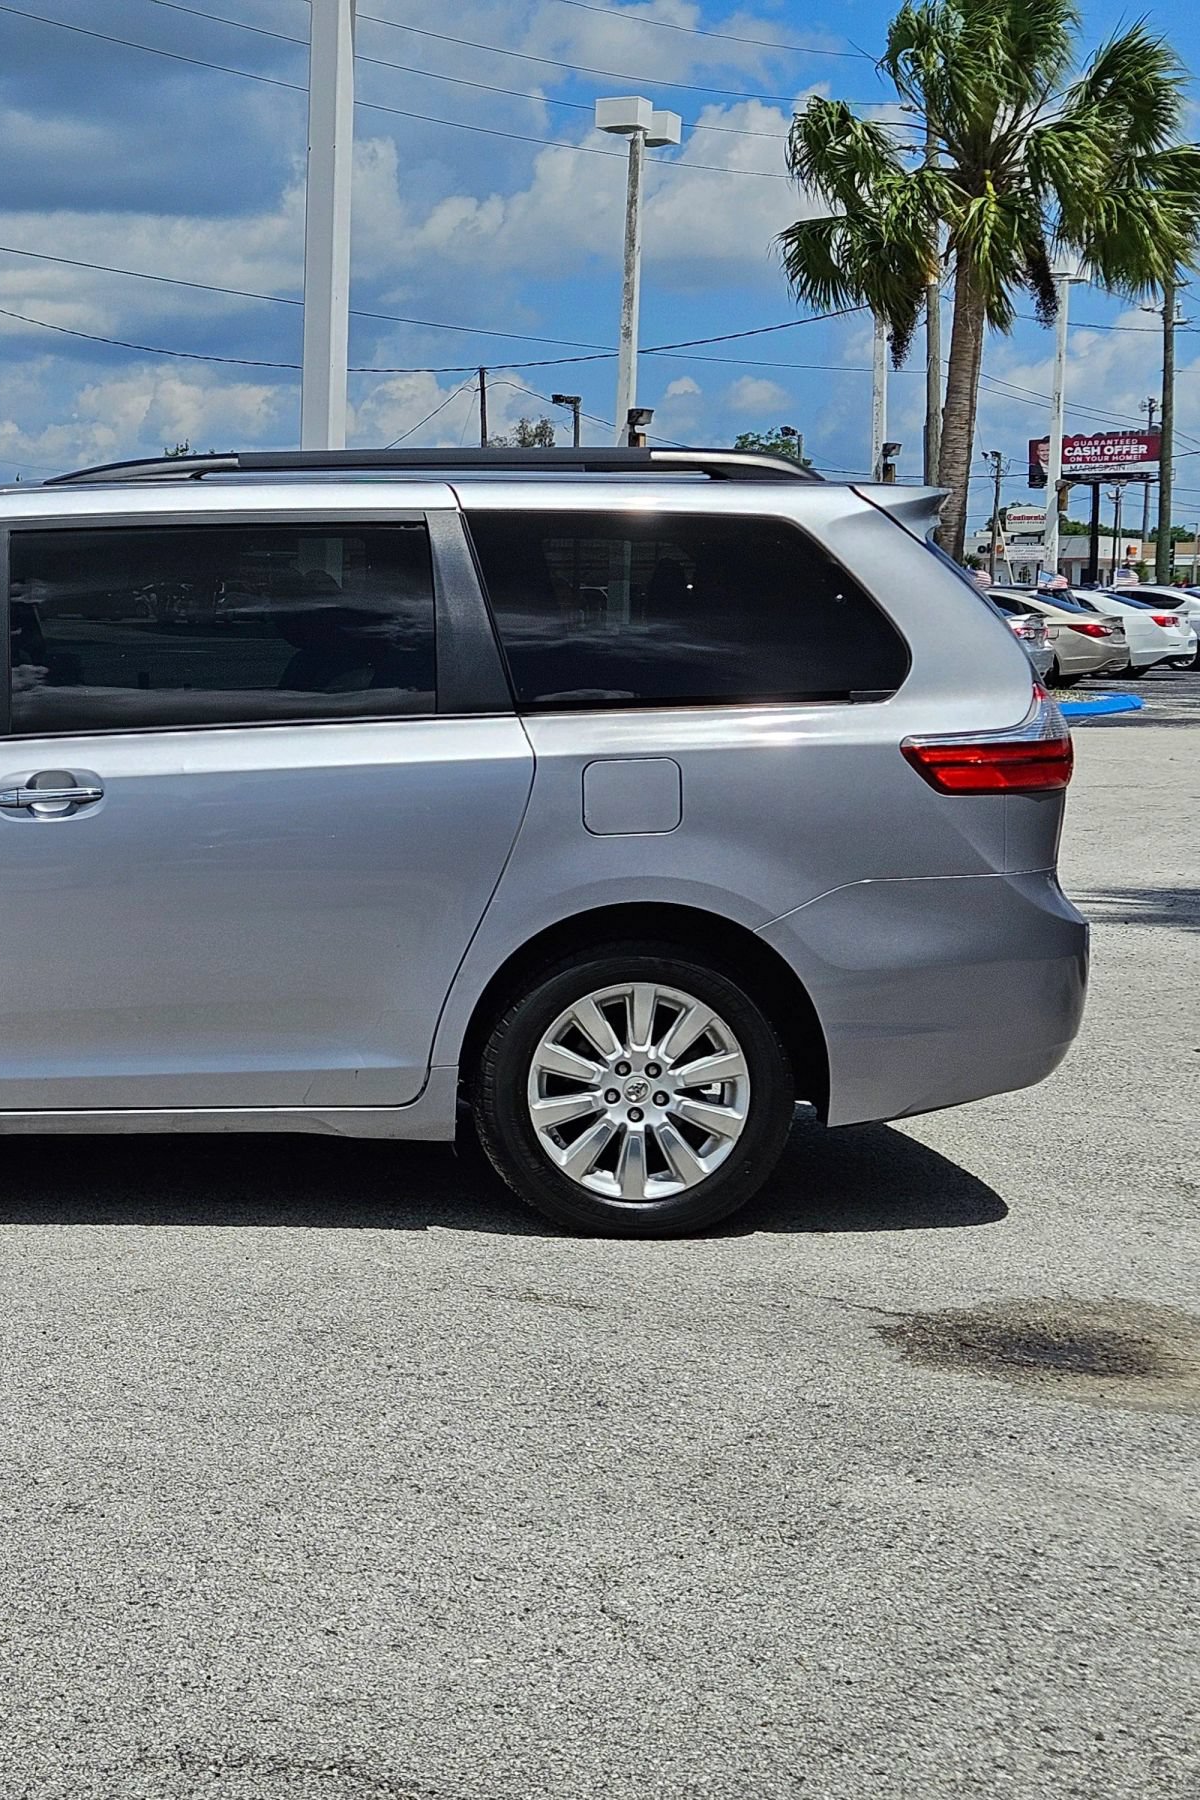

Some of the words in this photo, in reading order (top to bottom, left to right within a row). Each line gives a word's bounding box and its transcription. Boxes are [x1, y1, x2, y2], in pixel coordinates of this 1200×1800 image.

[1073, 438, 1138, 447] GUARANTEED
[1064, 446, 1101, 456] CASH
[1103, 444, 1148, 455] OFFER
